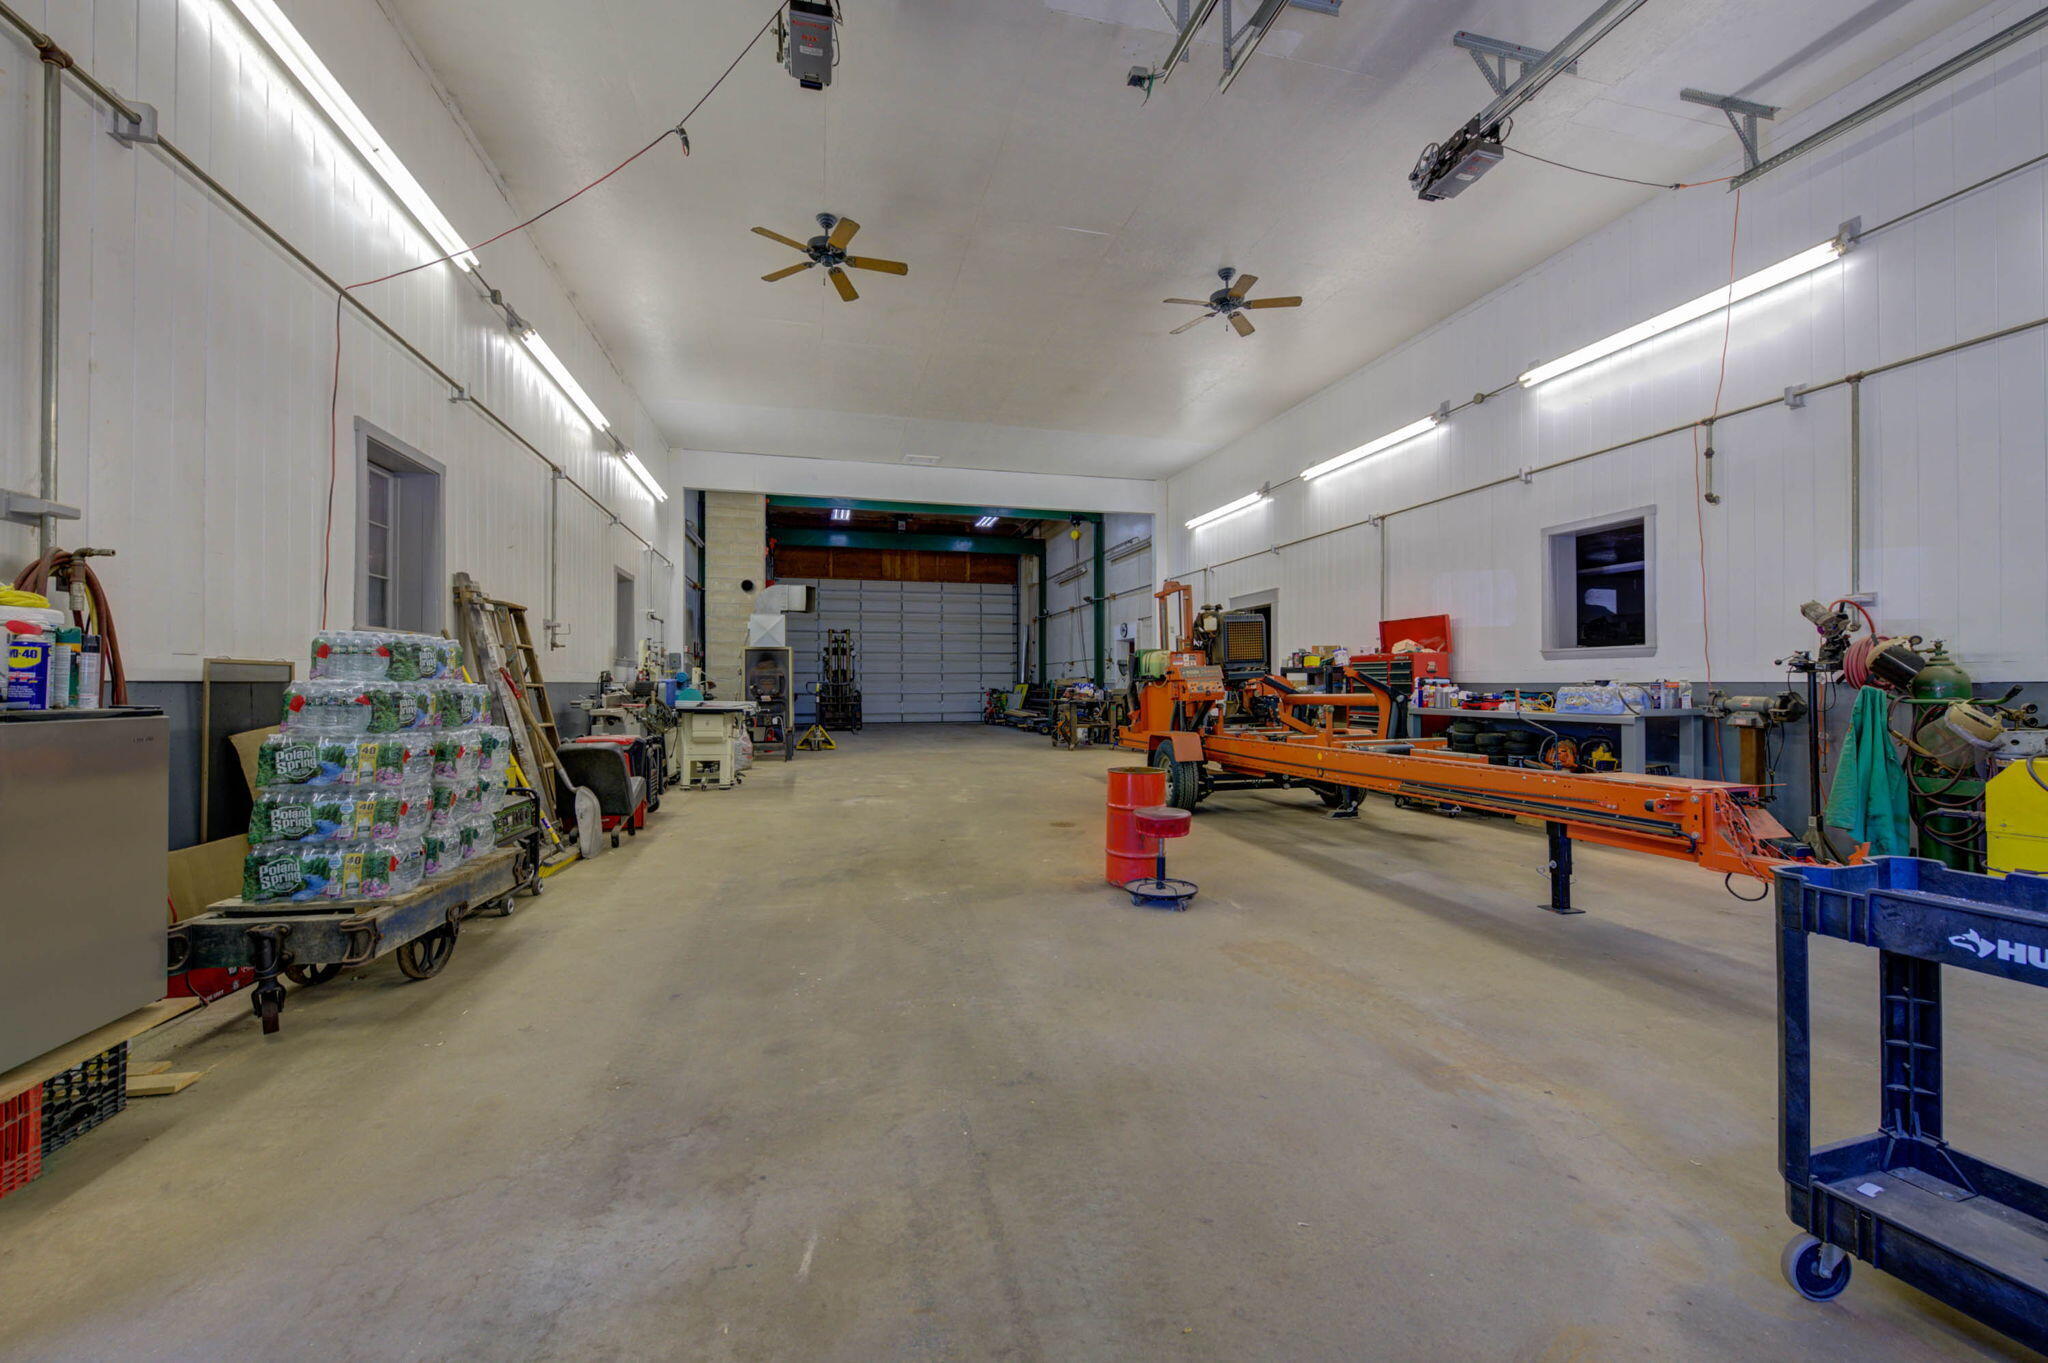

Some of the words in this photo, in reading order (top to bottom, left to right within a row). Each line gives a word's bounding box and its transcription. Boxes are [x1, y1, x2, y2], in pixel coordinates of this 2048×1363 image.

[275, 747, 316, 762] Poland
[276, 758, 318, 775] Spring
[271, 806, 311, 820] Poland
[271, 817, 312, 832] Spring
[260, 859, 300, 877] Poland
[260, 871, 302, 890] Spring
[1997, 938, 2048, 970] HU
